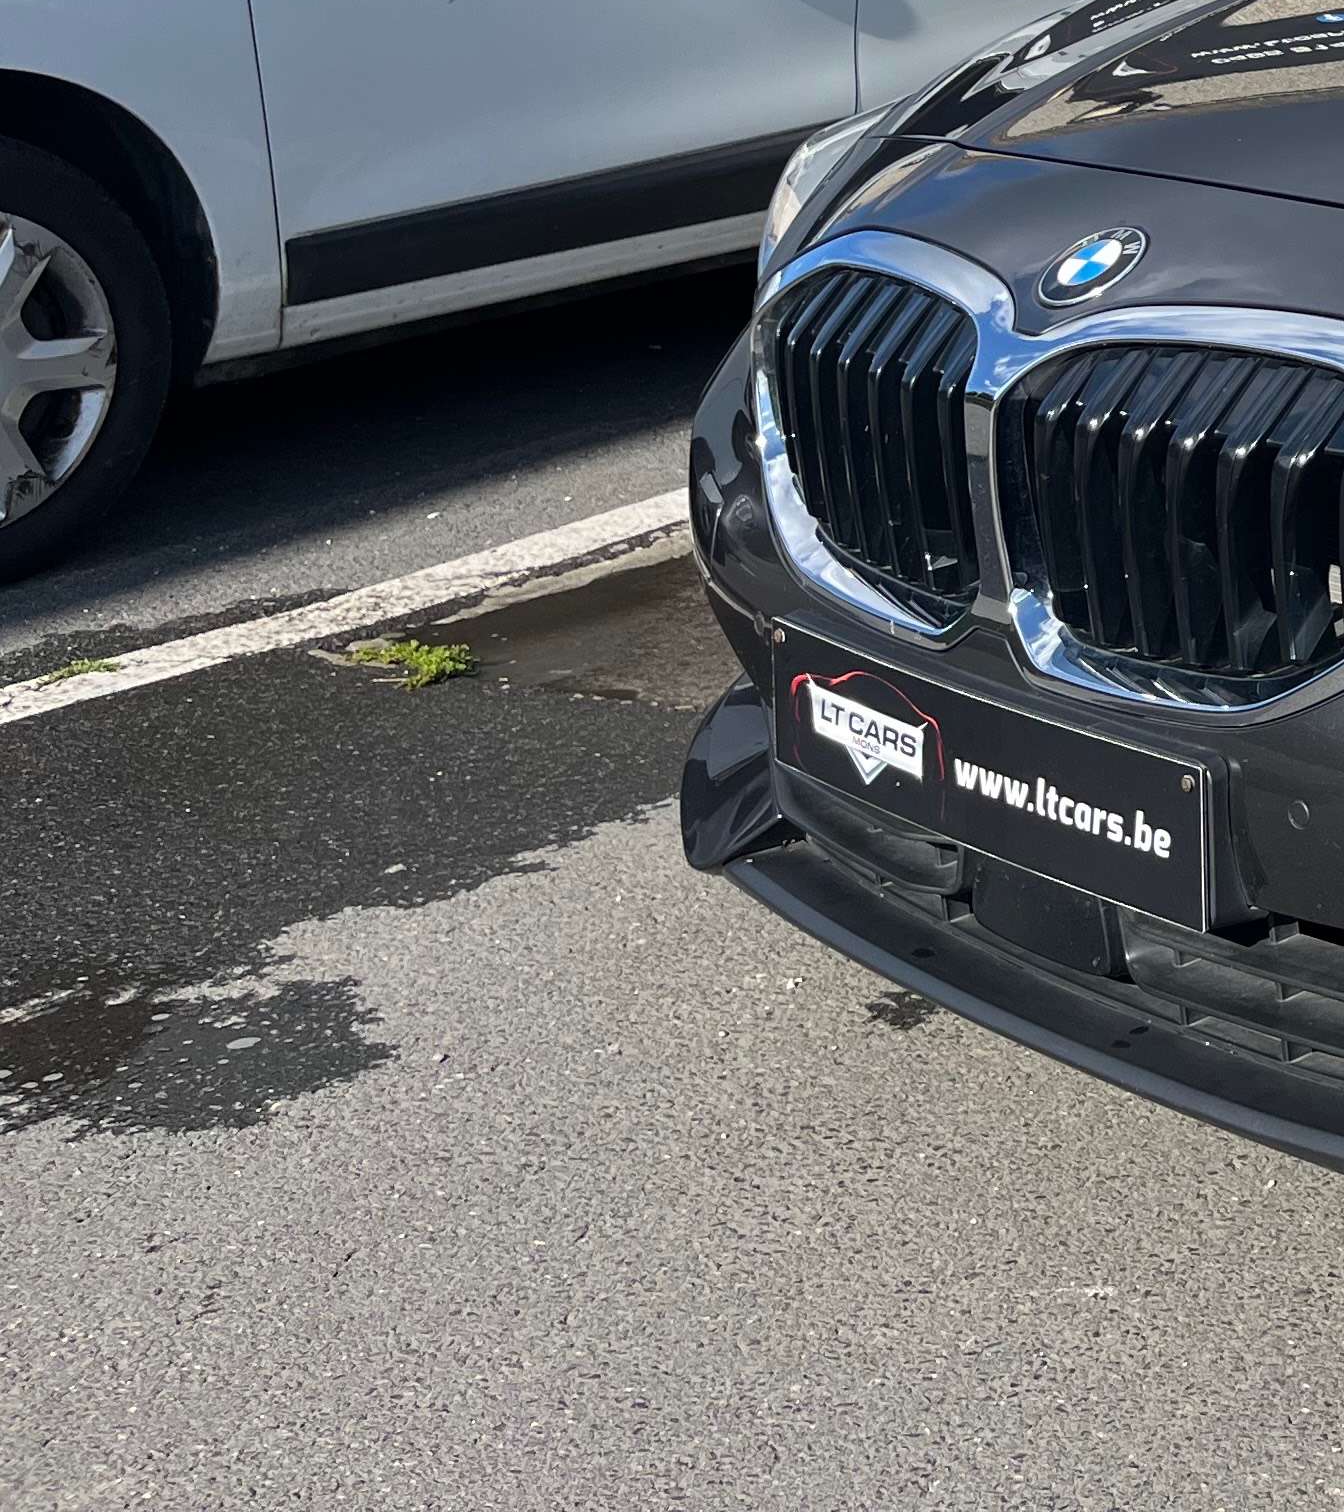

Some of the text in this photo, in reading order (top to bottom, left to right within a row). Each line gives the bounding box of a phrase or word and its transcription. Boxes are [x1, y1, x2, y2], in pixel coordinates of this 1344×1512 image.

[820, 699, 917, 758] LT CARS
[852, 736, 881, 755] MONS
[954, 758, 1171, 859] www.ltcars.be
